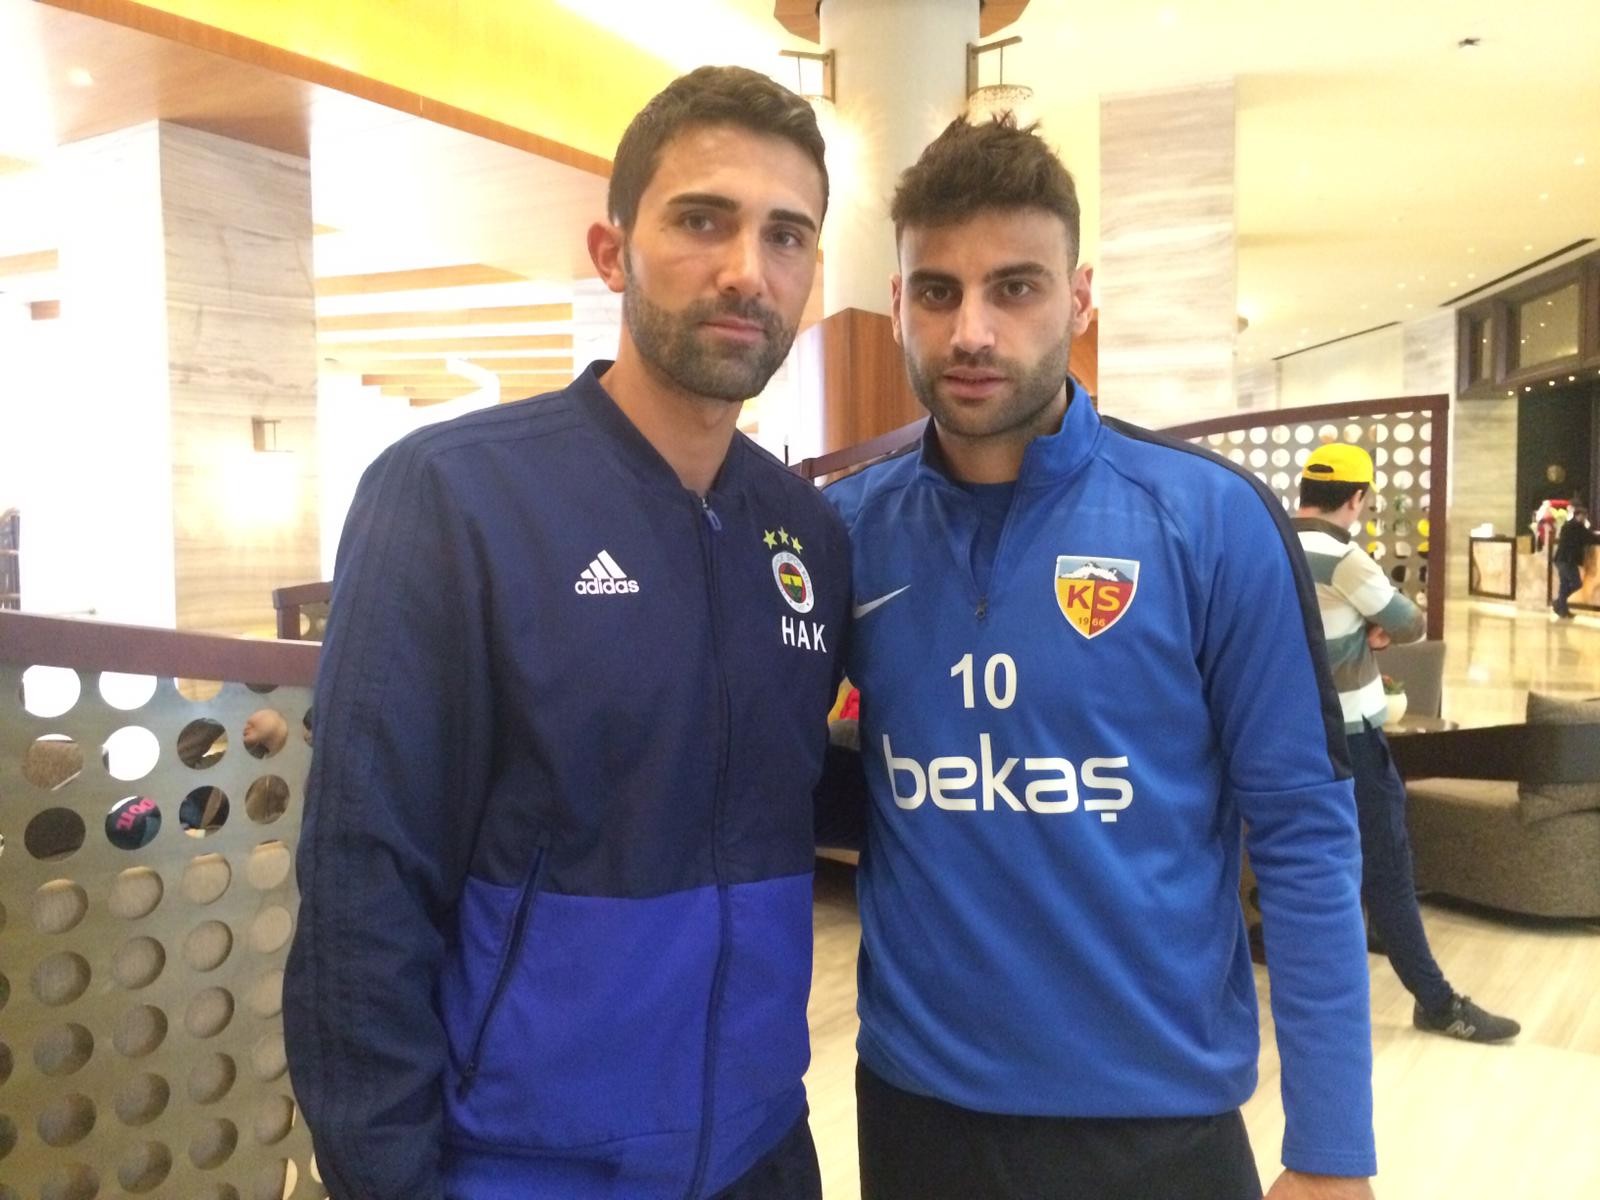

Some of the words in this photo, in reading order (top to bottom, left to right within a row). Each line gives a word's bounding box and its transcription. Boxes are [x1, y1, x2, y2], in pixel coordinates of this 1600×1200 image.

[575, 577, 640, 595] adidas
[781, 615, 827, 653] HAK
[950, 653, 1017, 709] 10
[882, 733, 1134, 822] bekaş
